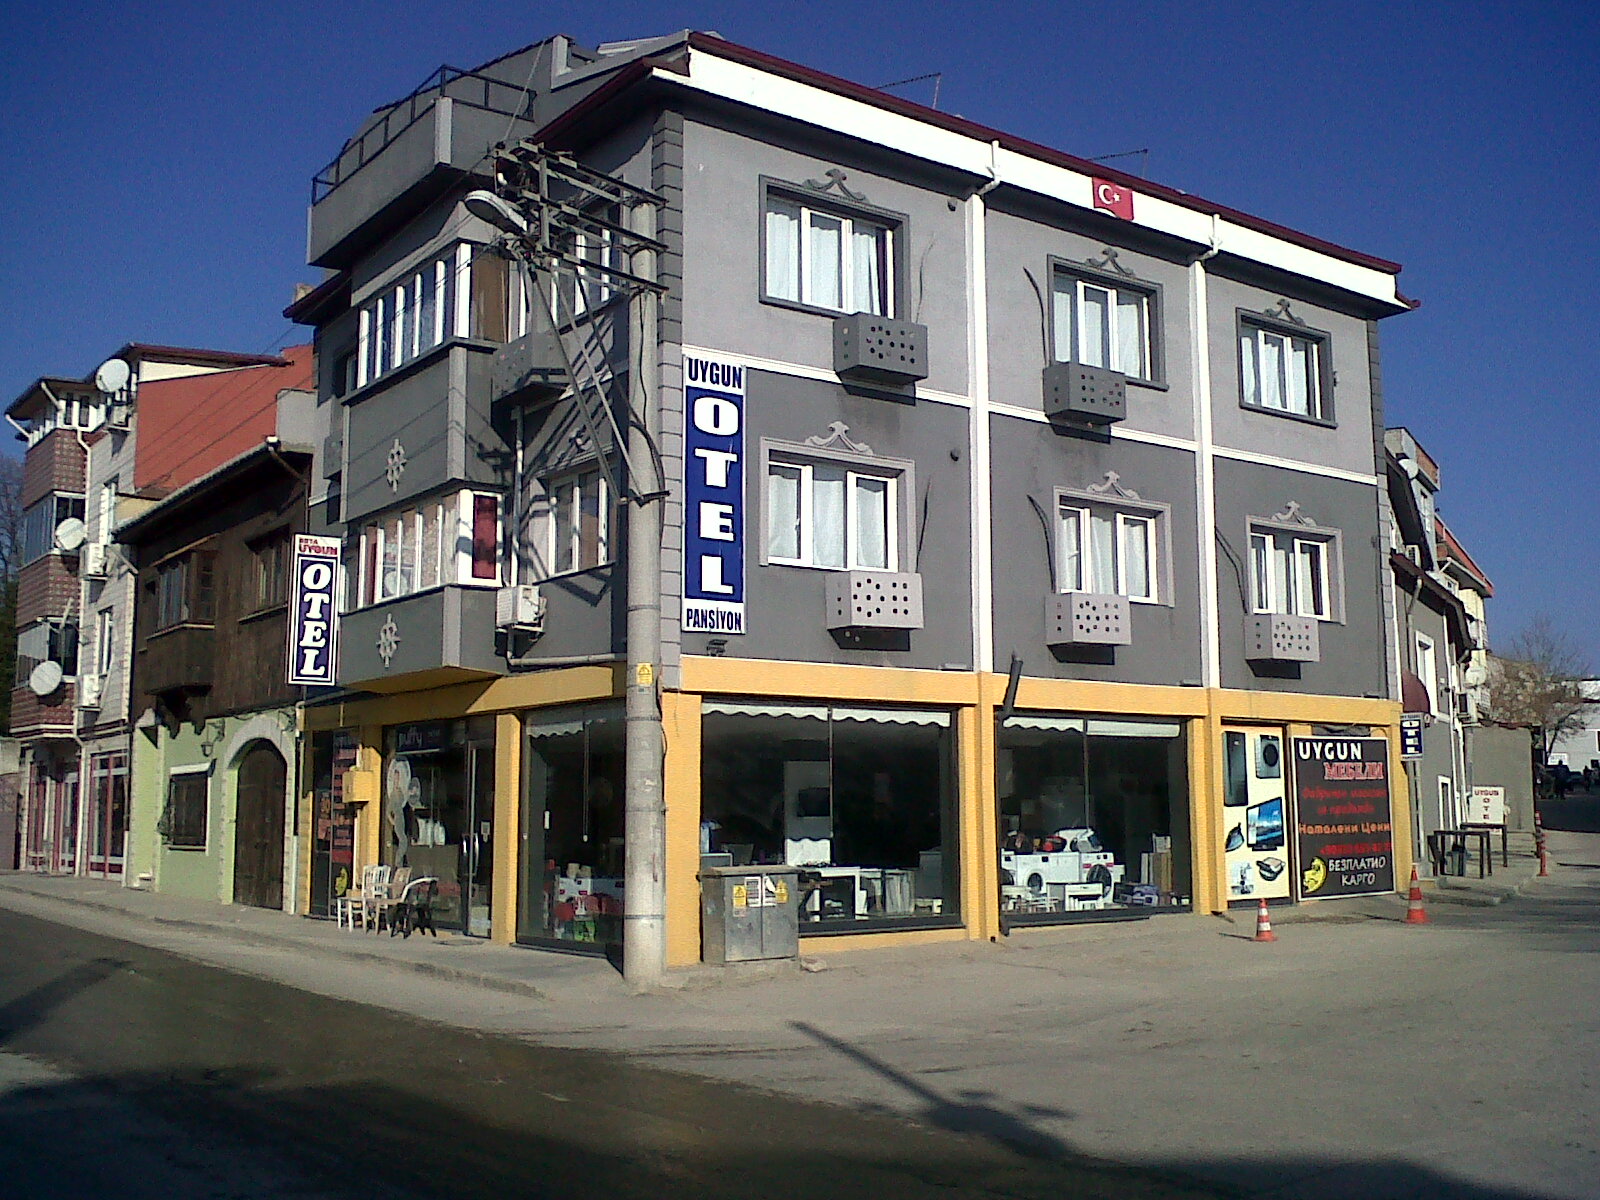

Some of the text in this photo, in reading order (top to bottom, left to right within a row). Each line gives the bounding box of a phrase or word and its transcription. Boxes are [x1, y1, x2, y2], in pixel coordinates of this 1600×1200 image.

[688, 358, 742, 389] UYGUN
[693, 396, 740, 595] OTEL
[299, 563, 332, 676] OTEL
[686, 607, 742, 631] PANSİYON
[1298, 741, 1362, 760] UYGUN
[1401, 720, 1420, 754] OTEL
[1341, 872, 1376, 887] КАРГО
